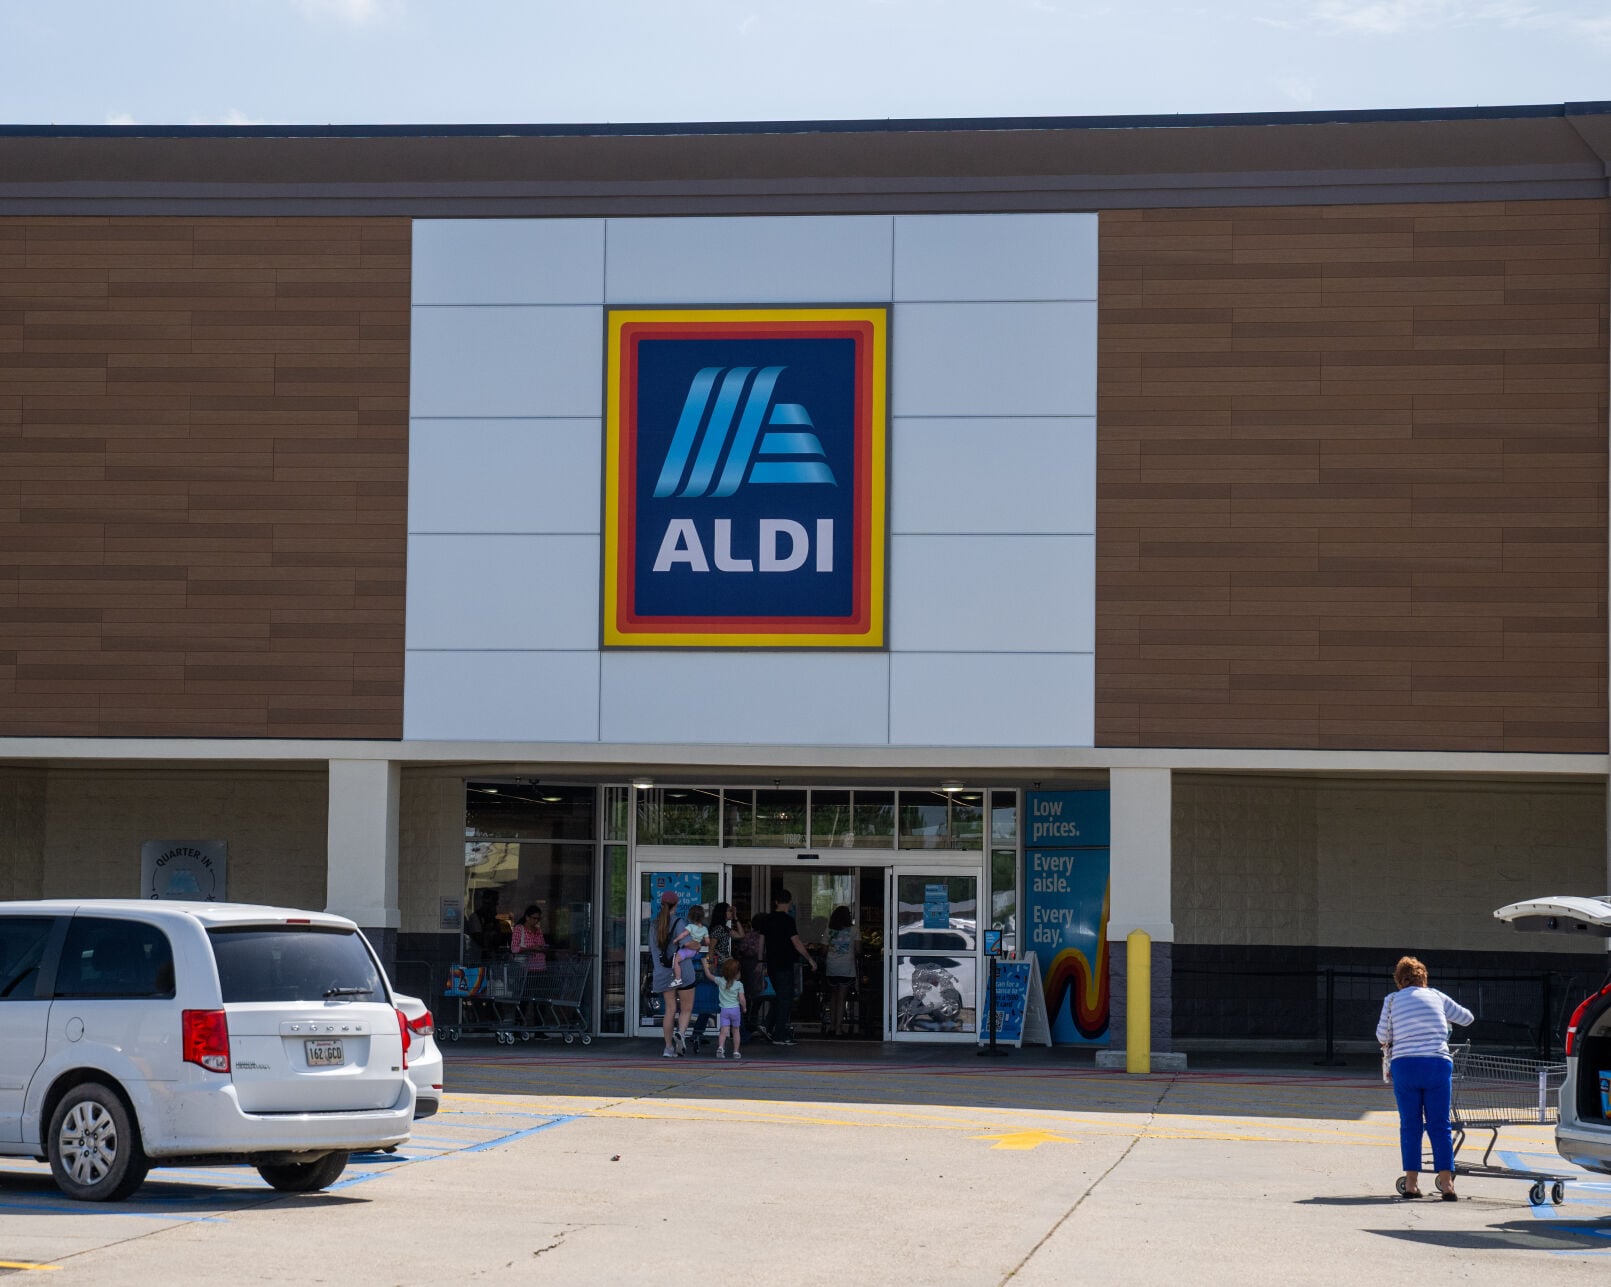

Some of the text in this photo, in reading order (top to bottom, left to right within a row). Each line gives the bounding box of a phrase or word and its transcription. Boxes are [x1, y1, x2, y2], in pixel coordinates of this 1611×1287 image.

[652, 518, 834, 573] ALDI
[1033, 798, 1063, 816] Low
[1033, 817, 1080, 842] prices.
[156, 847, 212, 868] QUARTER IN
[1033, 853, 1074, 876] Every
[1033, 873, 1071, 893] aisle.
[1033, 905, 1074, 928] Every
[1033, 923, 1063, 948] day.
[310, 1048, 323, 1060] 162
